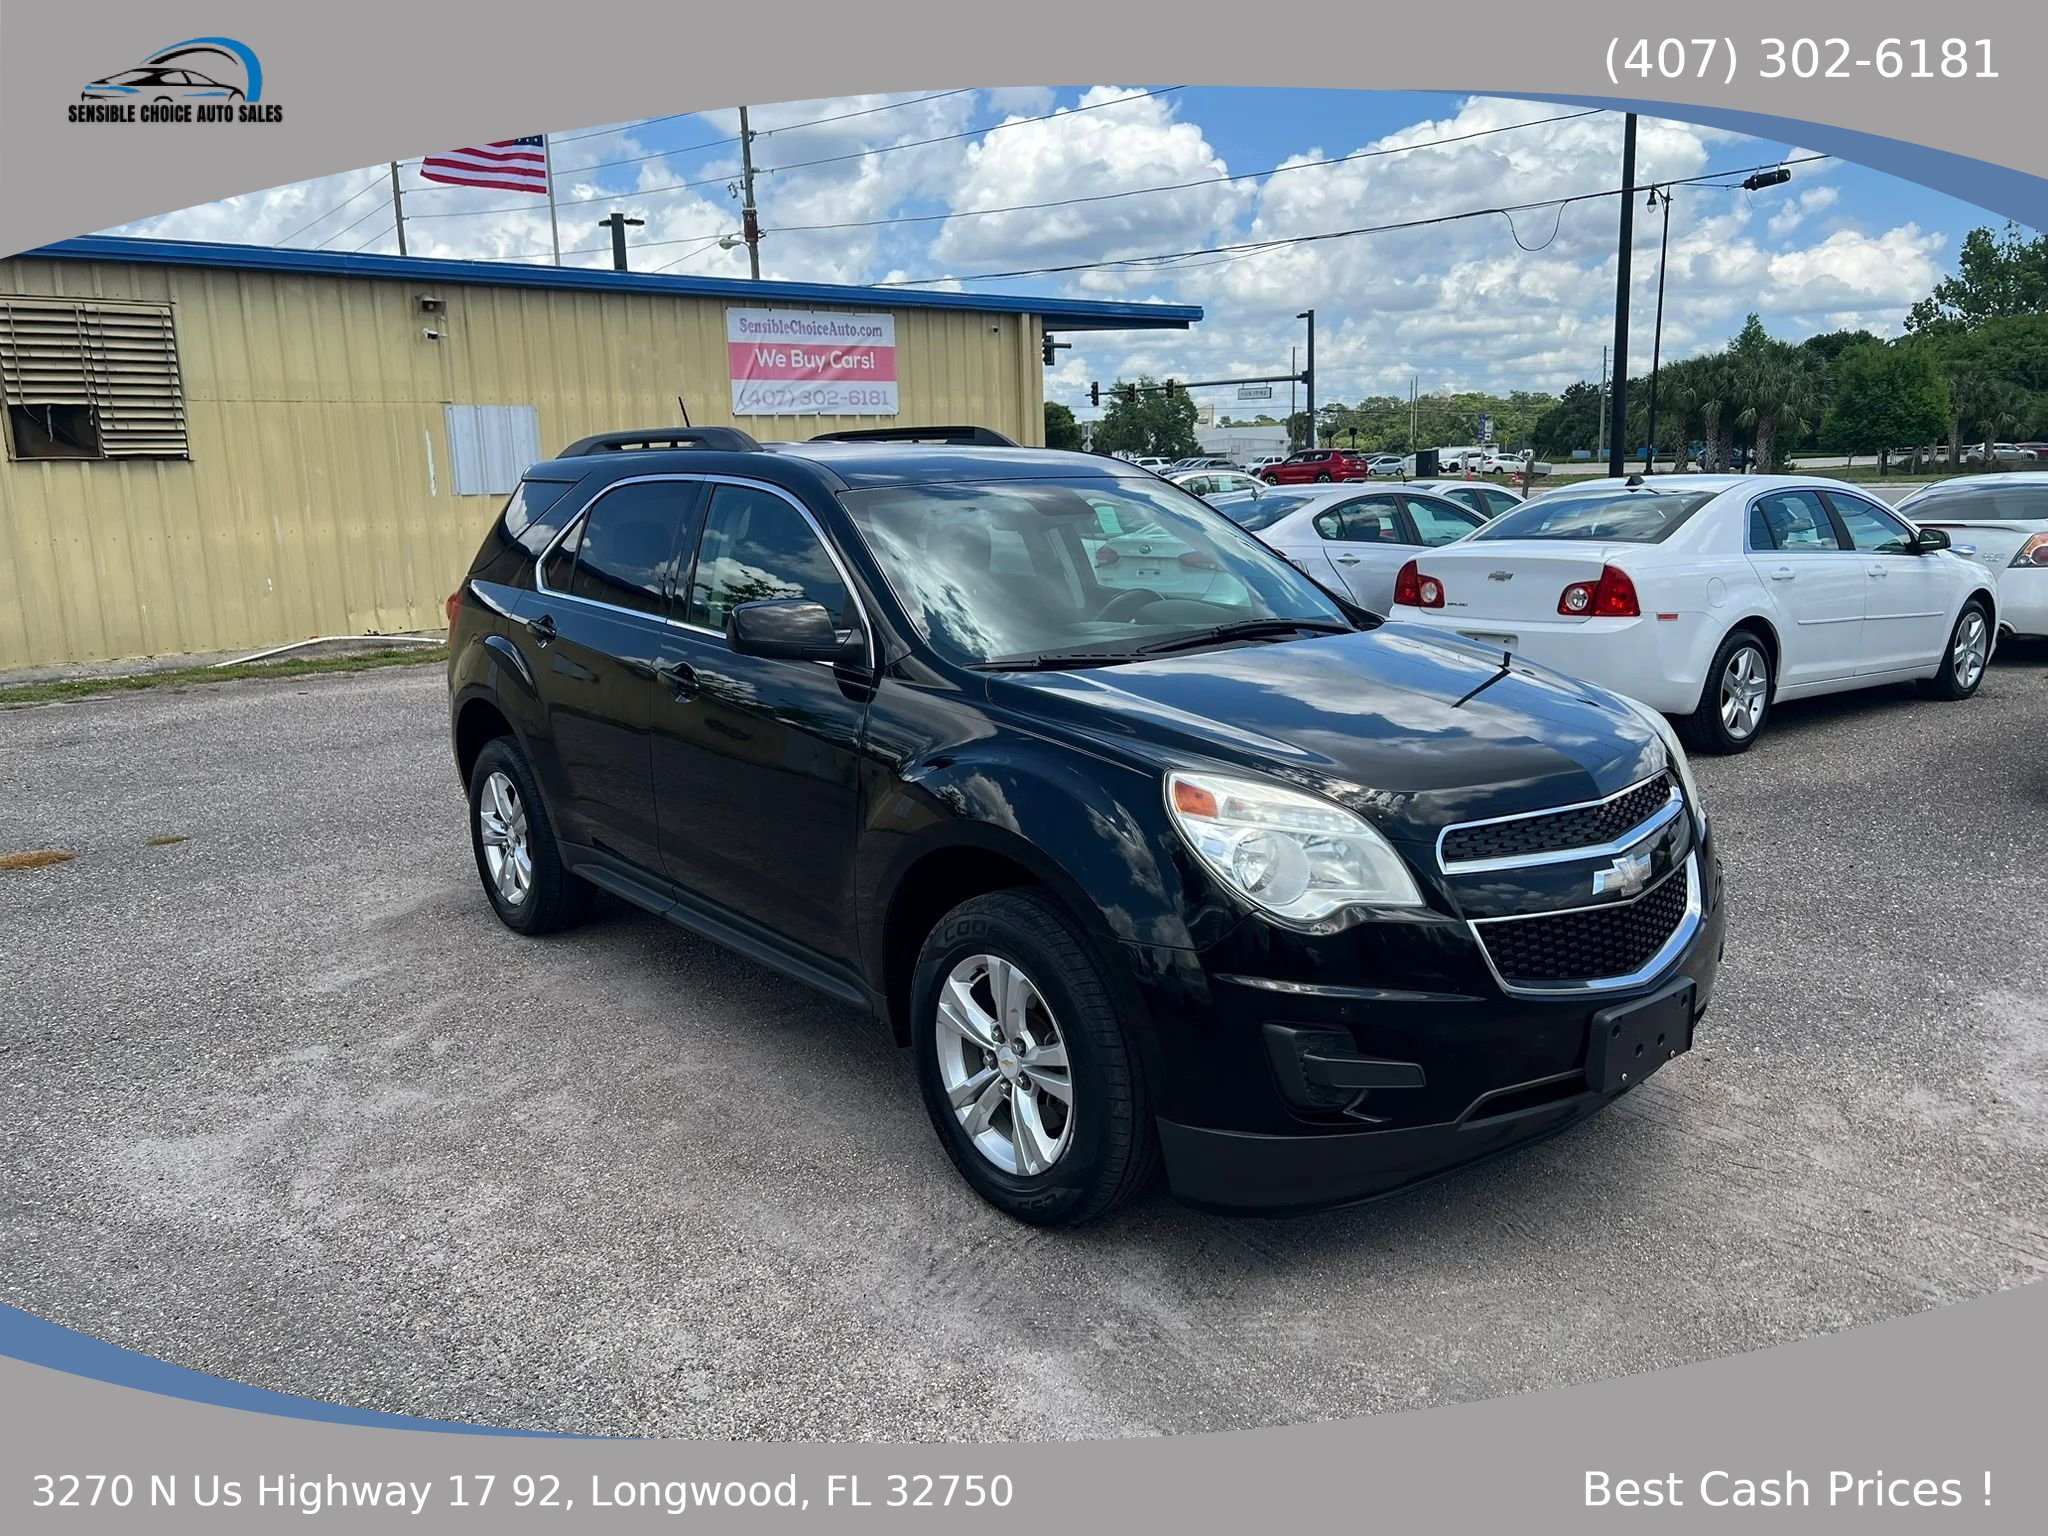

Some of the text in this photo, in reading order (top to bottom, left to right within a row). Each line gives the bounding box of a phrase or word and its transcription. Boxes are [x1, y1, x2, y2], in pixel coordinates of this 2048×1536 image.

[739, 317, 883, 338] SensibleChoiceAuto.com
[755, 348, 876, 373] We Buy Cars!
[739, 388, 889, 408] (407) 302-6181
